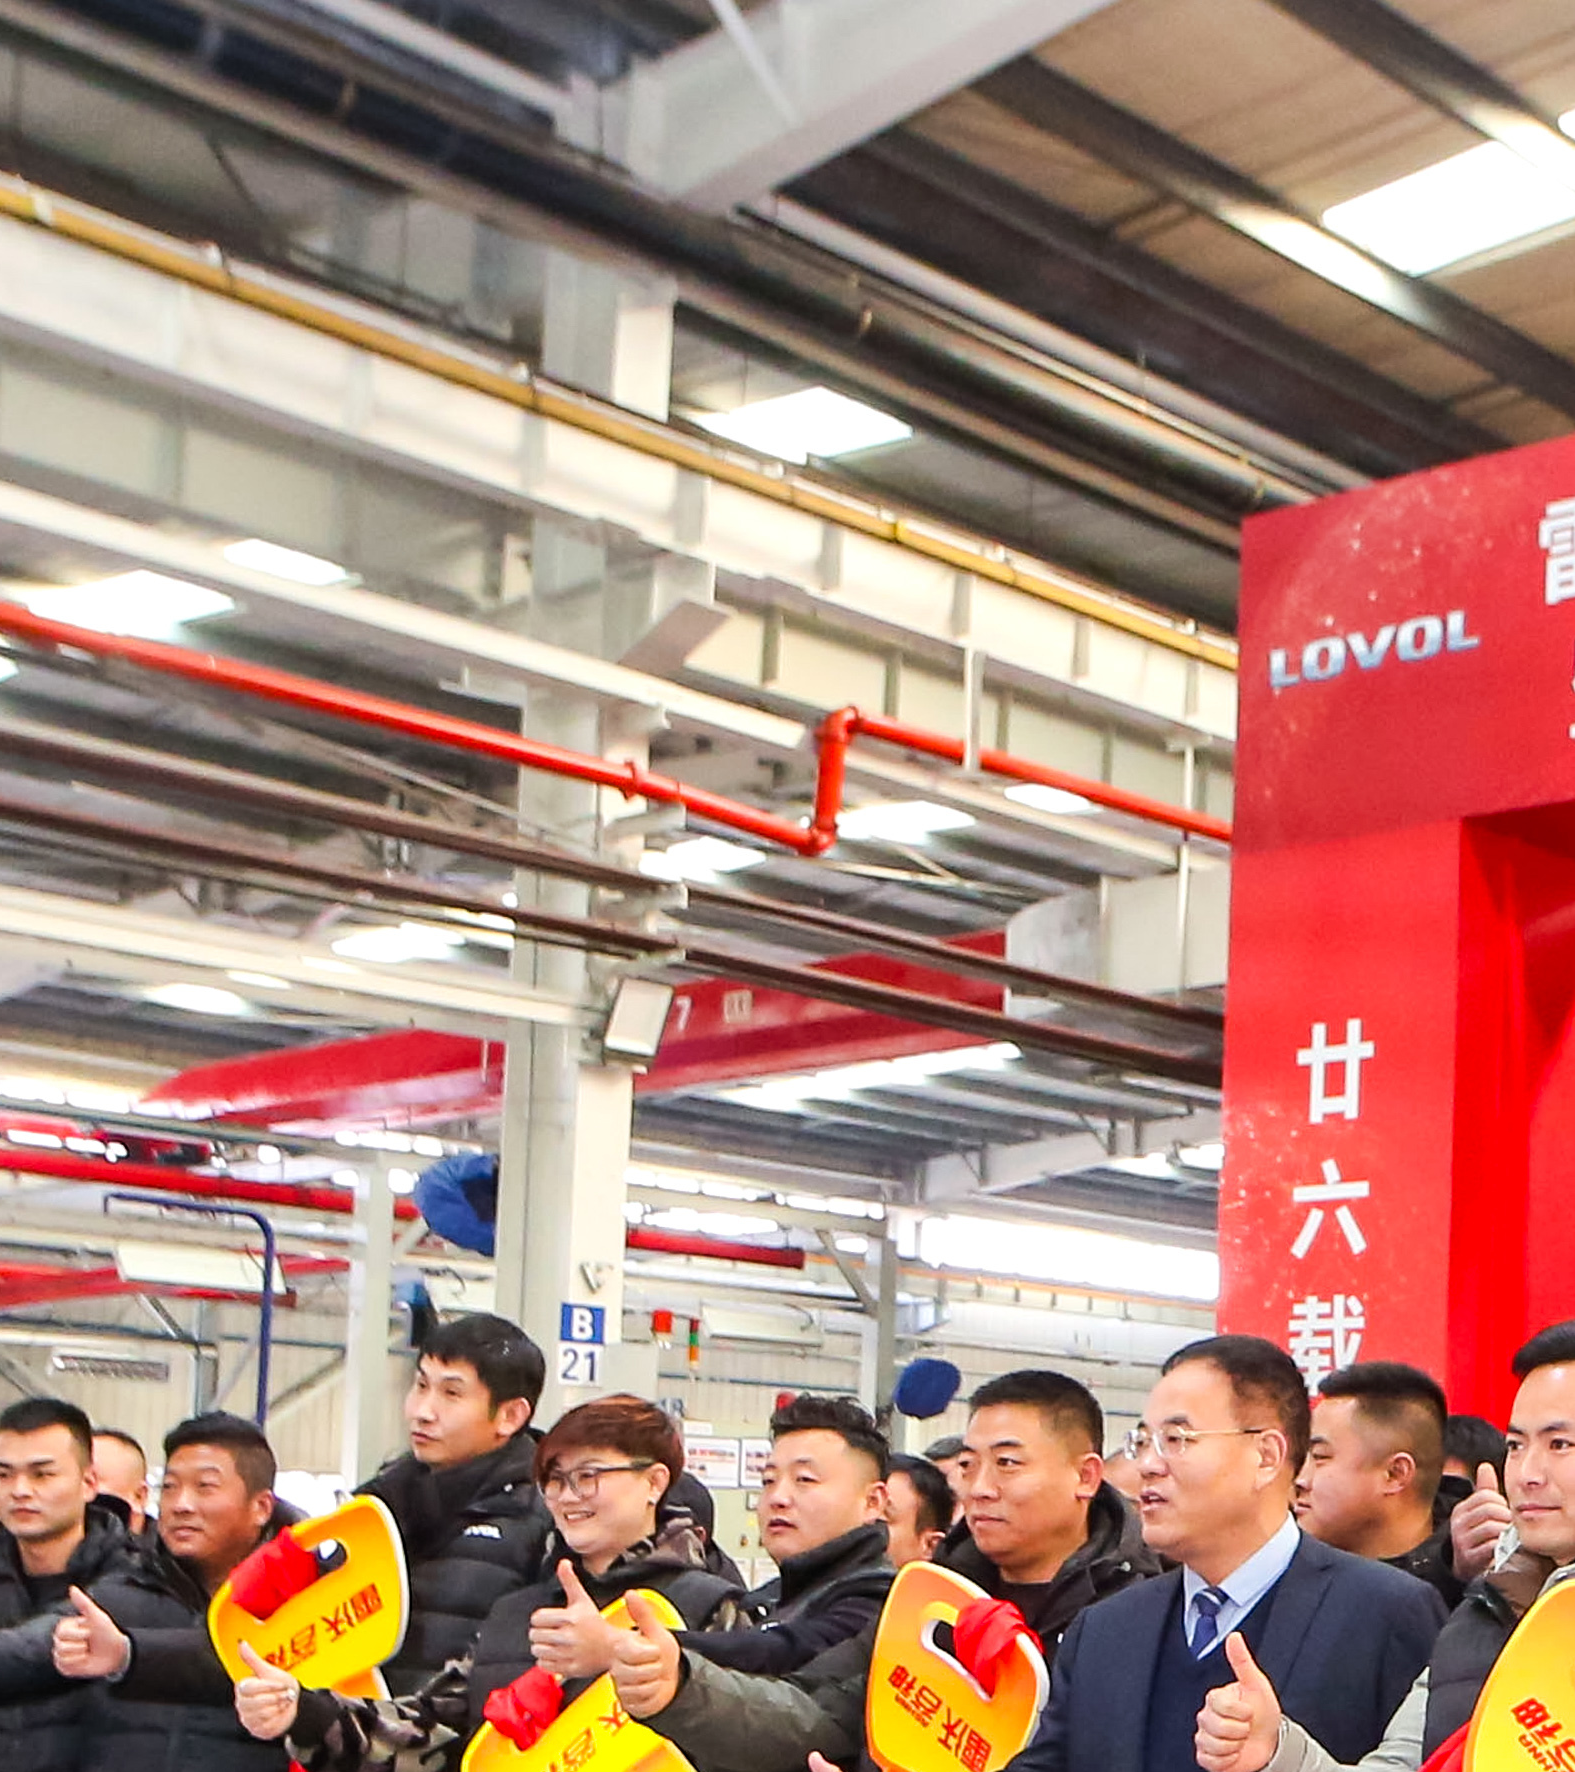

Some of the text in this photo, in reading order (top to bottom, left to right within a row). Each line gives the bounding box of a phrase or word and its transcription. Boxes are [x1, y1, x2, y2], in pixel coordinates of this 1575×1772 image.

[1269, 609, 1480, 688] LOVOL
[571, 1306, 594, 1341] B
[561, 1348, 595, 1382] 21
